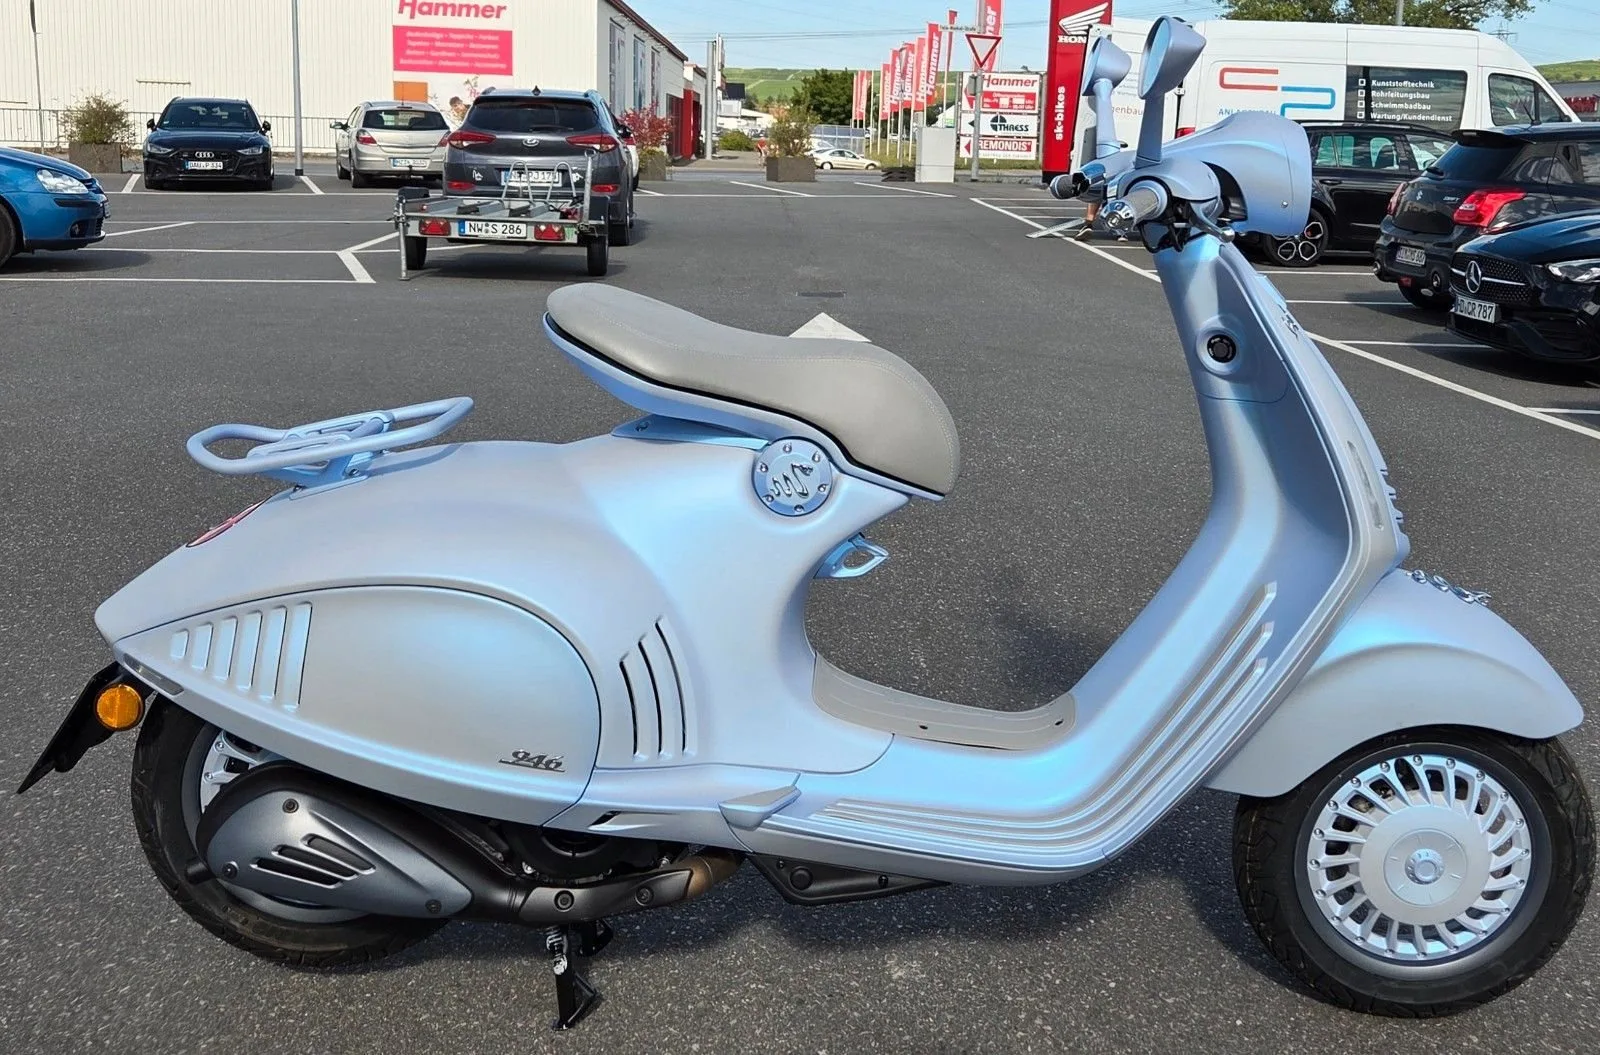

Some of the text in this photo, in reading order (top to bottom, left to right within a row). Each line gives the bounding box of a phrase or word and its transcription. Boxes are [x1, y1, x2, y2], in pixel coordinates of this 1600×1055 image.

[398, 0, 507, 19] Hammer
[1057, 35, 1087, 43] HON
[925, 32, 940, 95] Hammer
[982, 75, 1037, 88] Hammer
[1371, 80, 1435, 88] Kunststofftechnik
[1371, 91, 1430, 100] Rohrleitungsbau
[1370, 101, 1431, 110] Schwimmbadbau
[1053, 86, 1066, 140] sk-bikes
[1370, 112, 1452, 121] Wartung/Kundendienst
[979, 140, 1028, 152] REMONDIS
[468, 222, 522, 235] NW S 286
[1467, 301, 1476, 317] CR
[1478, 303, 1494, 321] 787
